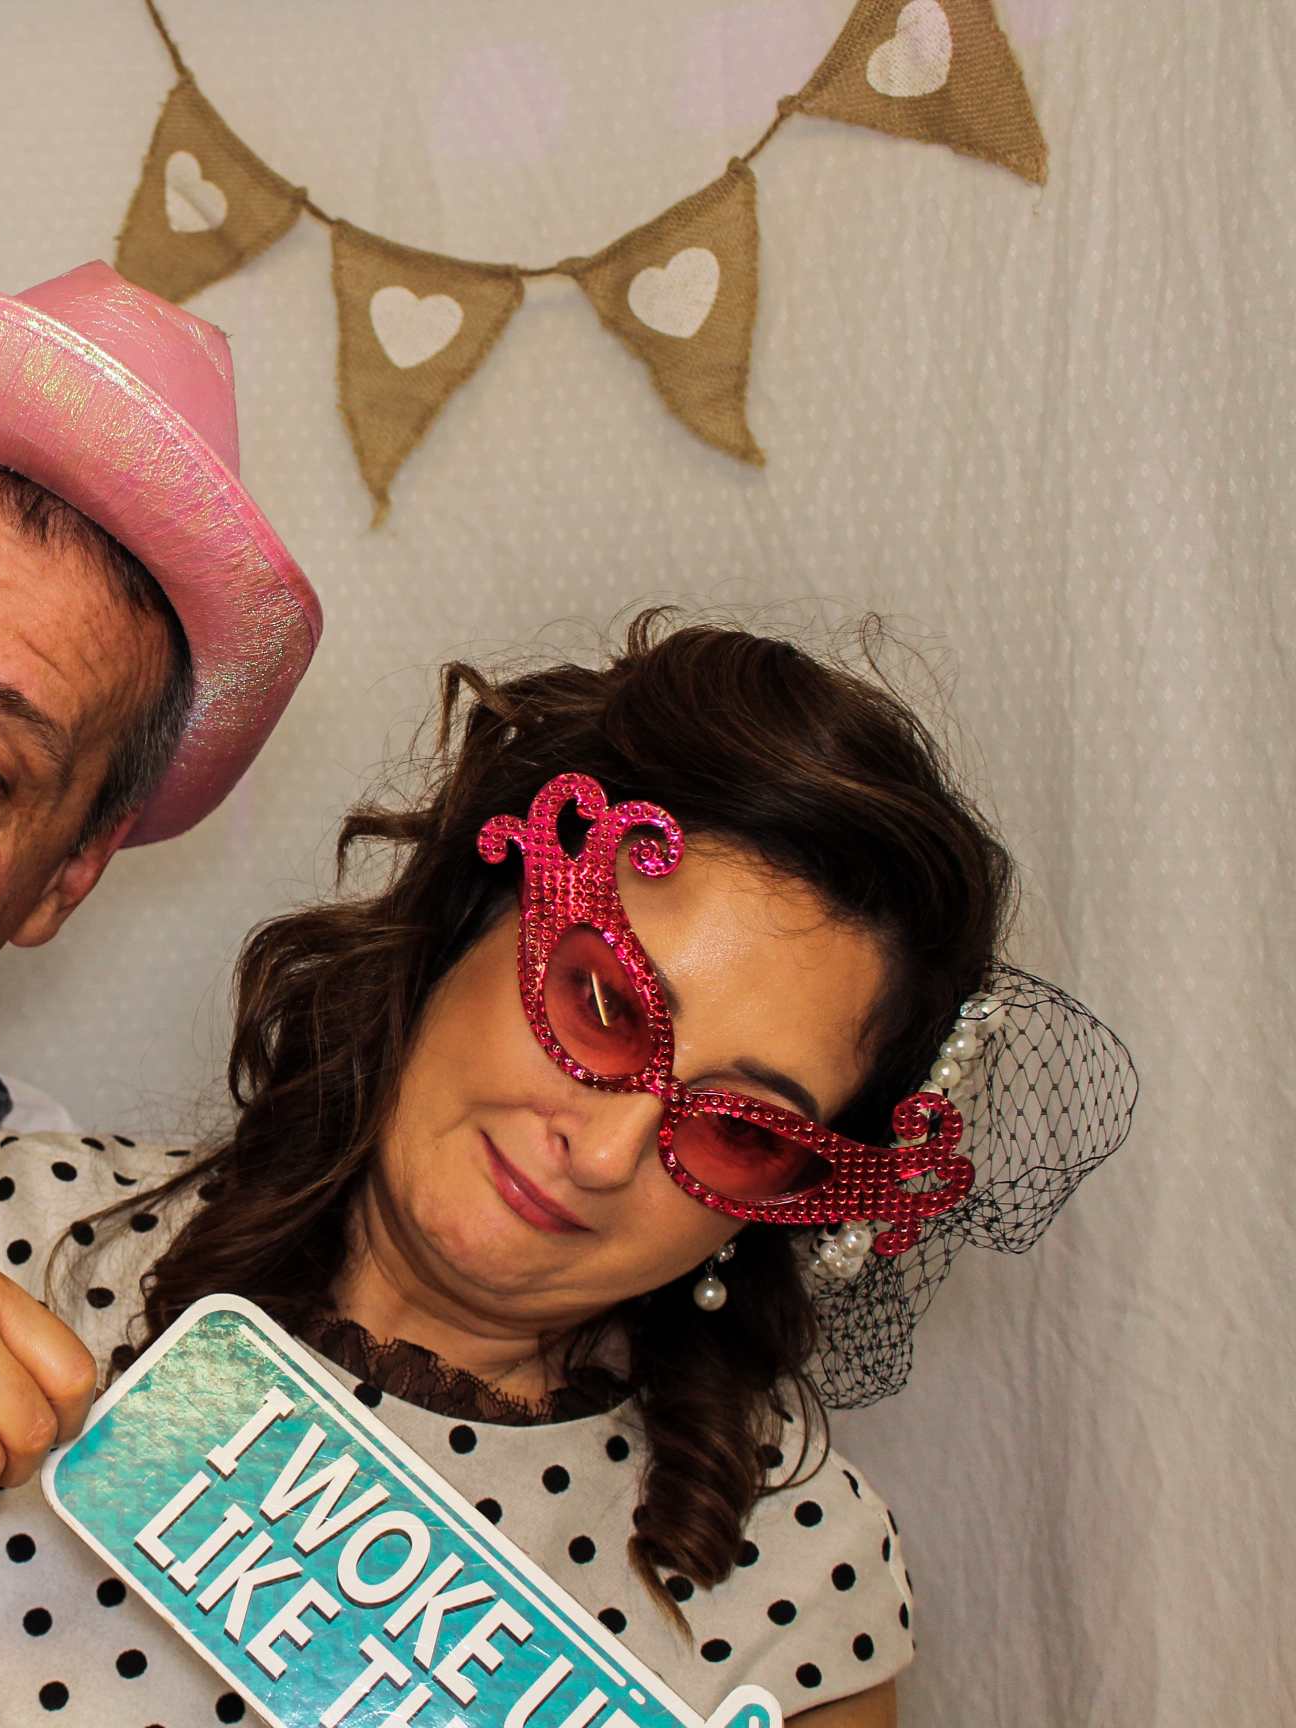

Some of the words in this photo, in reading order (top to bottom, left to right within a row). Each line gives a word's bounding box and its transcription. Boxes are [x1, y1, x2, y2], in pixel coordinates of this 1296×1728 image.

[134, 1470, 342, 1681] LIKE
[206, 1386, 296, 1477] I
[259, 1422, 535, 1708] WOKE
[504, 1654, 641, 1728] U
